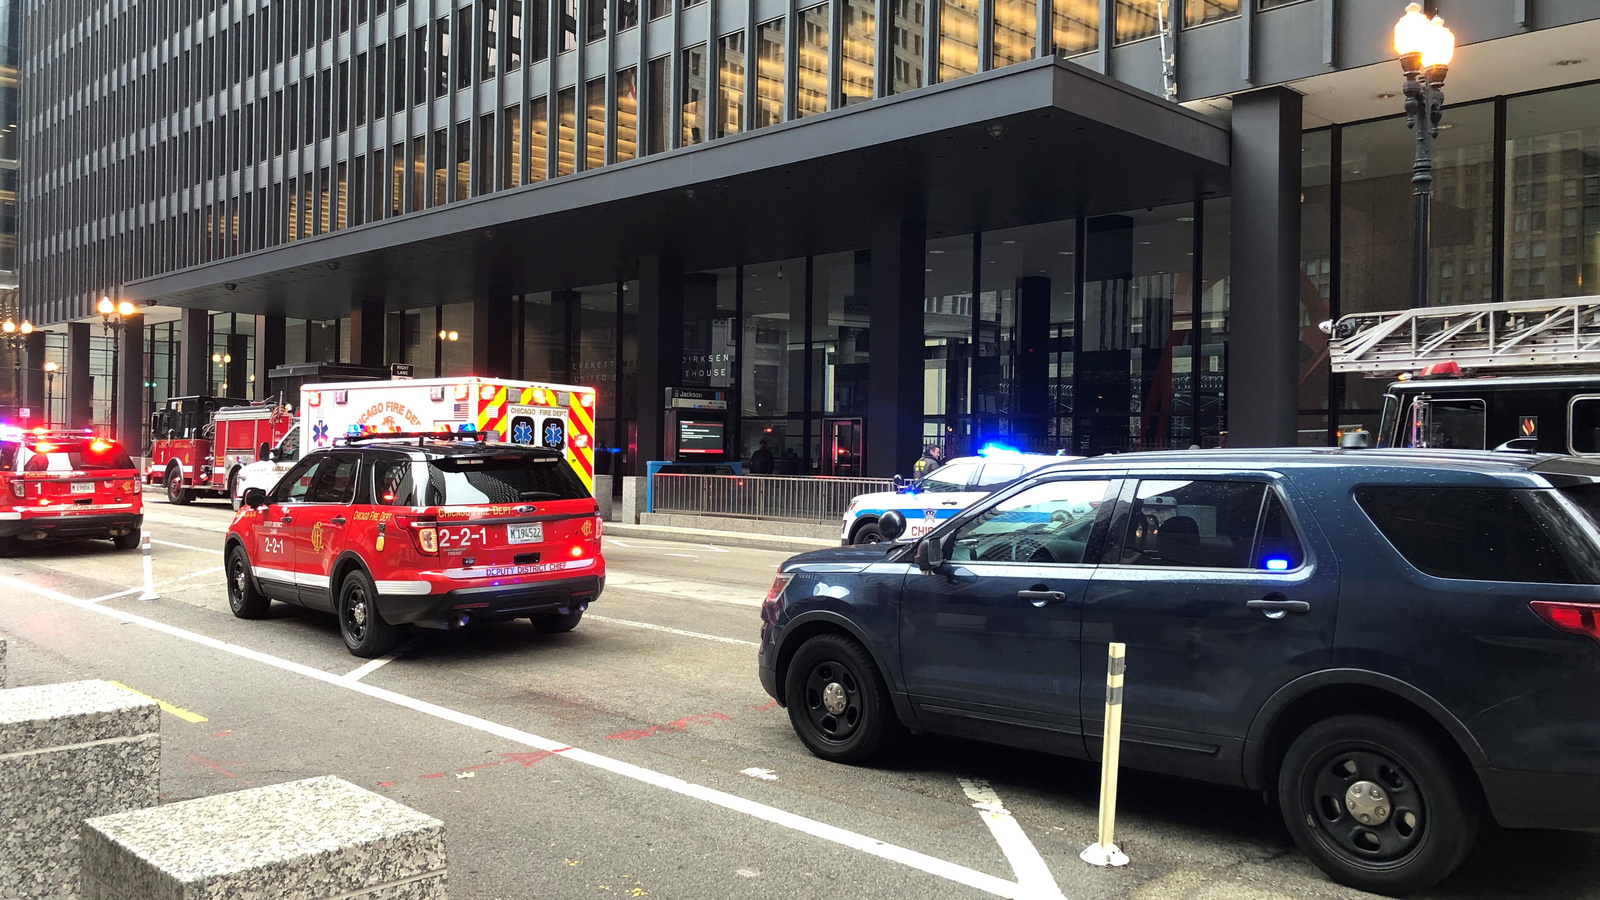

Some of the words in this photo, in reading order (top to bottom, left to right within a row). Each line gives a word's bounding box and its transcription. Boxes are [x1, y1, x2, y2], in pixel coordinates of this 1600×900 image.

[572, 360, 614, 370] EVERETT
[574, 374, 607, 383] UNITED
[684, 368, 726, 378] THOUSE
[386, 401, 405, 416] FIRE
[510, 407, 536, 415] CHICAGO
[160, 451, 164, 463] 1
[34, 482, 42, 495] 1
[439, 527, 487, 548] 2-2-1
[517, 528, 541, 539] 194522
[265, 537, 284, 554] 2-2-1
[486, 567, 515, 576] DEPUTY
[517, 564, 547, 574] DISTRICT
[549, 562, 567, 571] CHIEF
